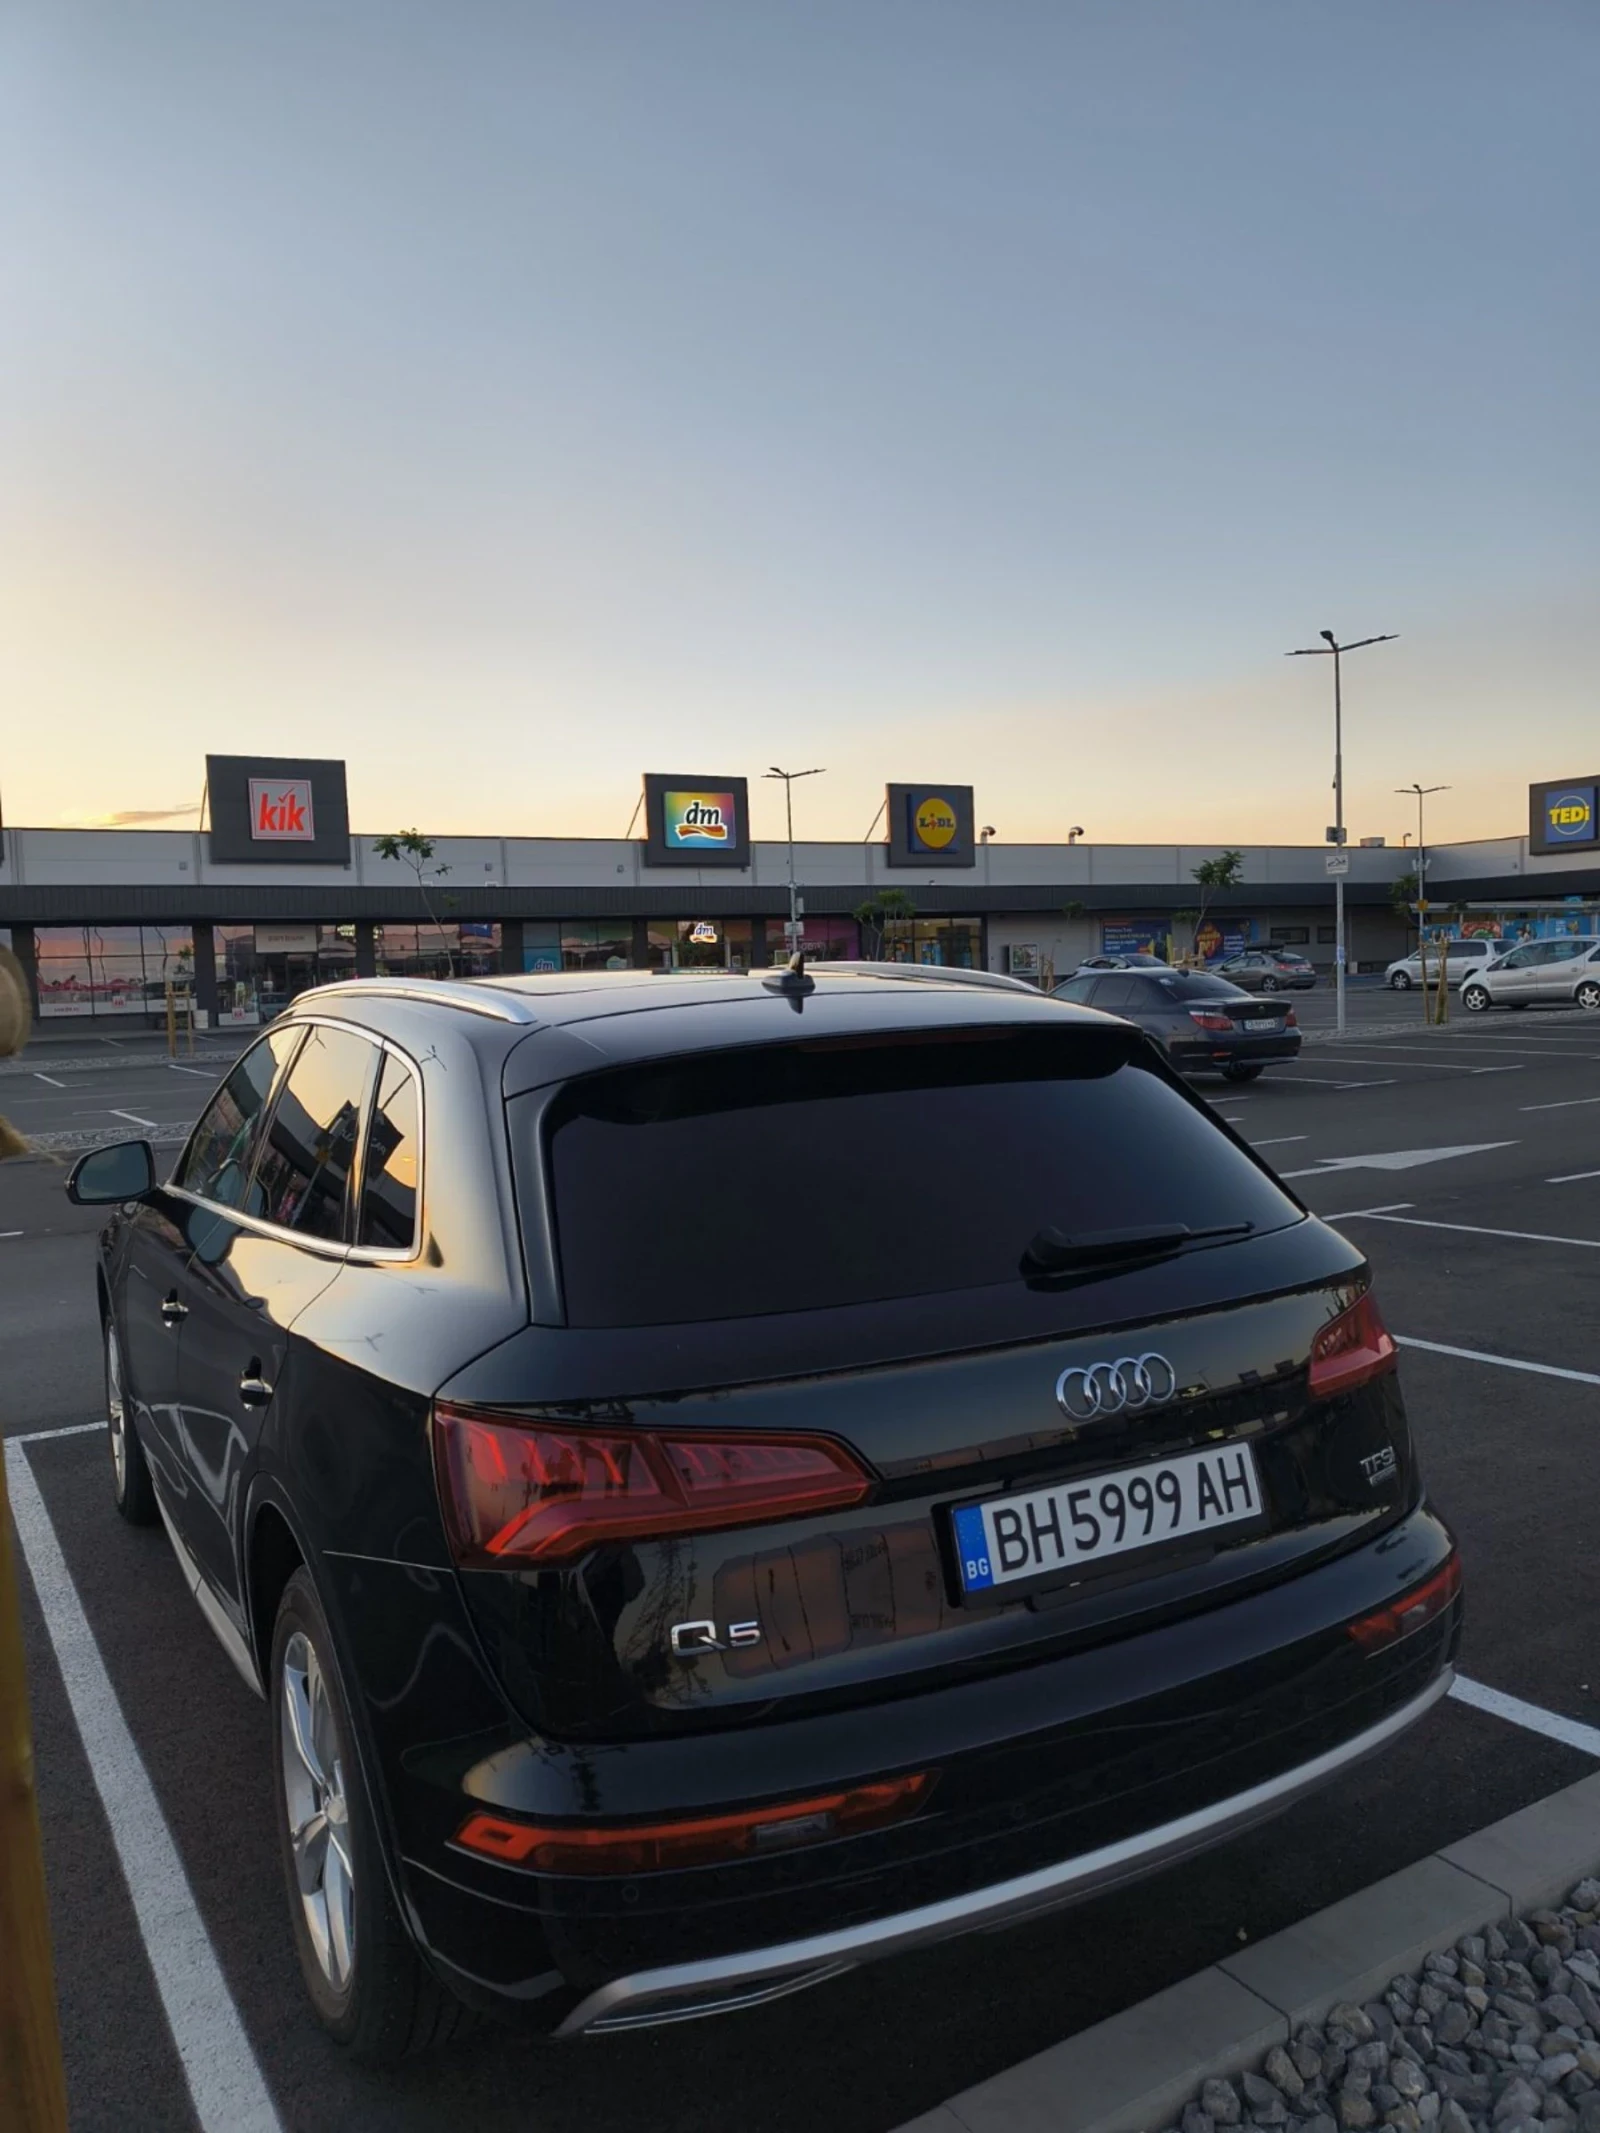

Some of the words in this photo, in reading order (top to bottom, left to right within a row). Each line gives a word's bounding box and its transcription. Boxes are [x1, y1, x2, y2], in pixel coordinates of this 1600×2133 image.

[260, 789, 306, 831] kik
[685, 800, 720, 825] dm
[1549, 805, 1590, 825] TEDi
[695, 923, 714, 936] dm
[535, 959, 554, 971] dm
[1197, 1452, 1254, 1522] AH
[966, 1556, 990, 1581] BG
[671, 1620, 761, 1656] Q5
